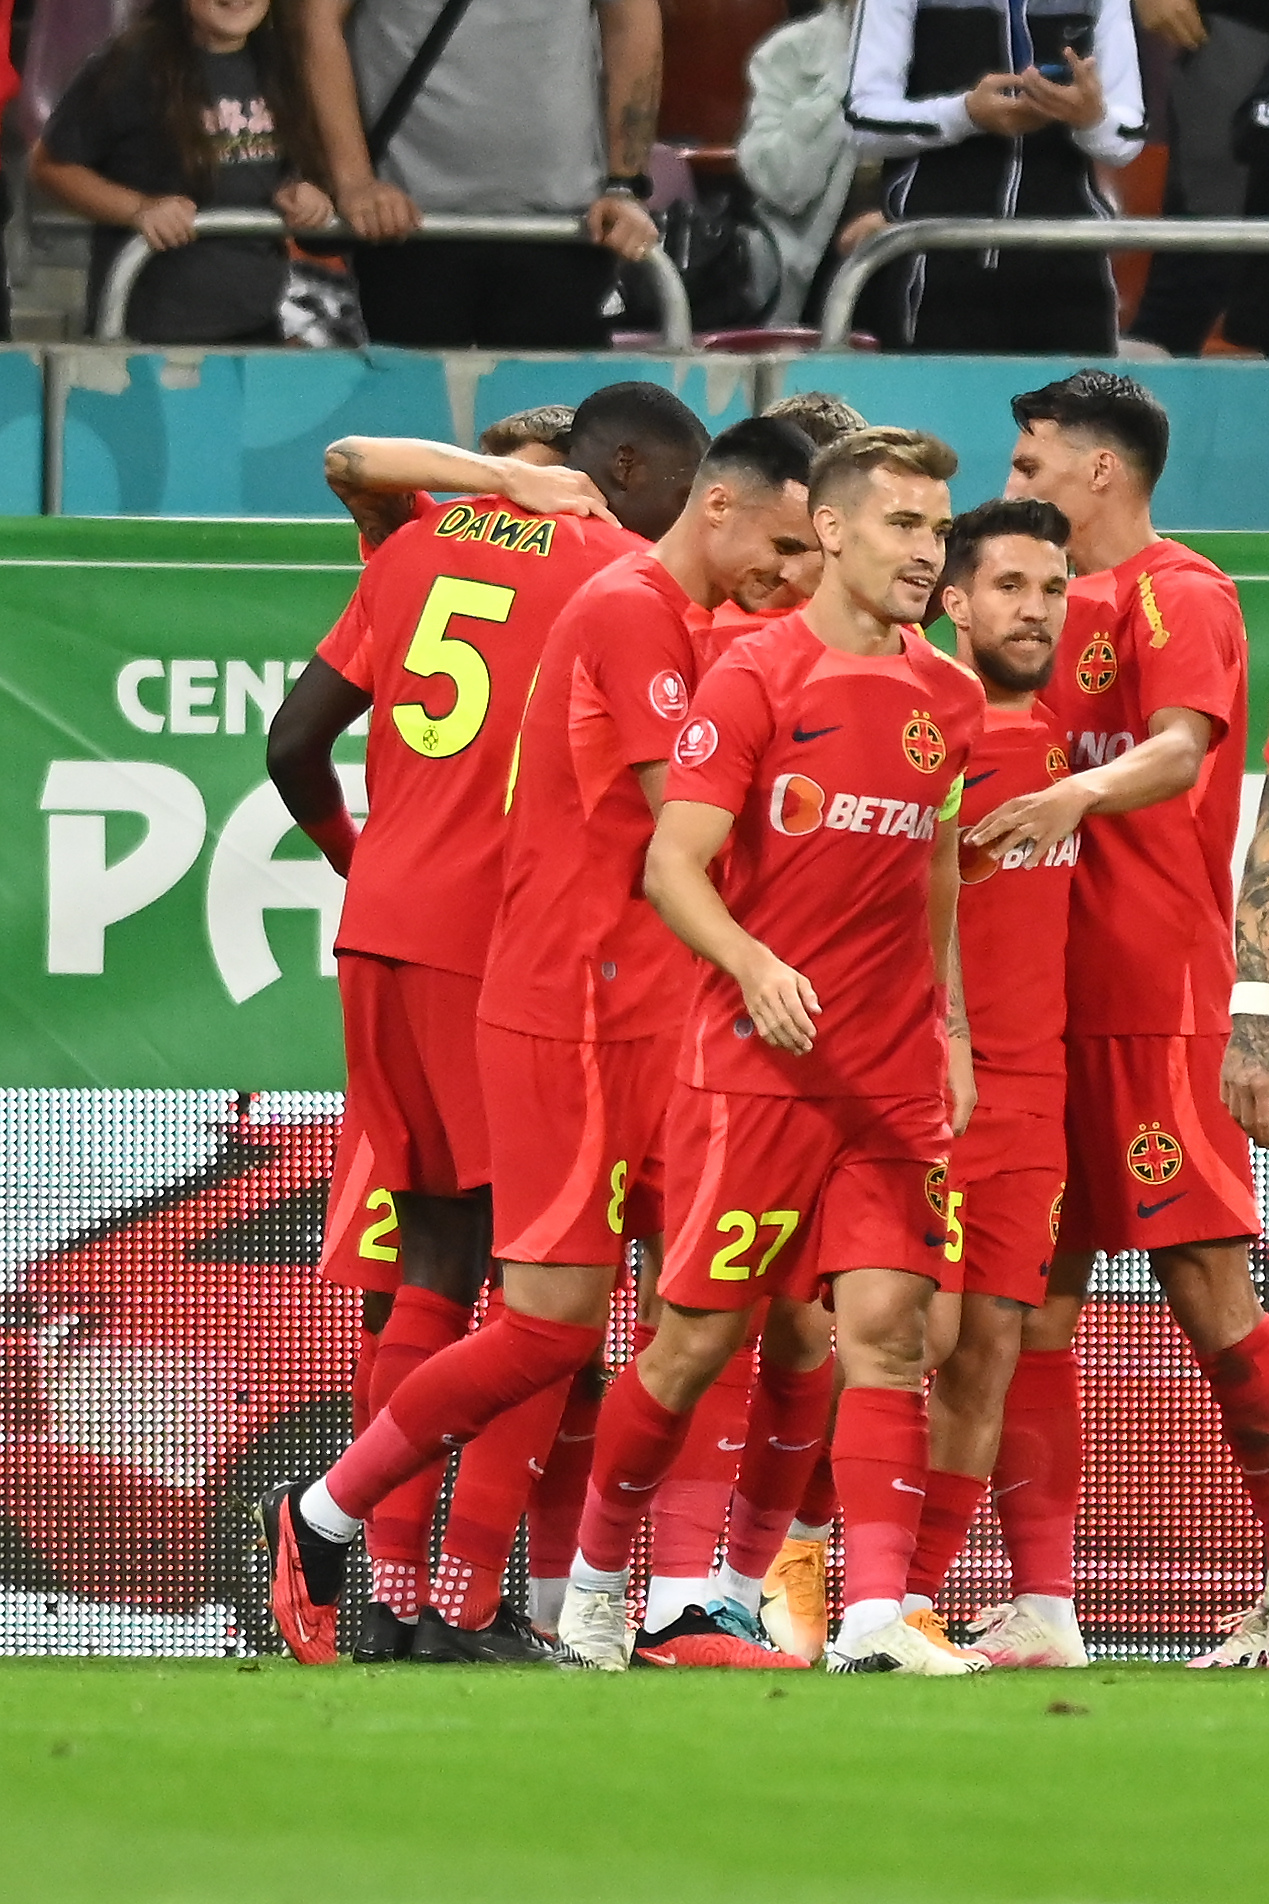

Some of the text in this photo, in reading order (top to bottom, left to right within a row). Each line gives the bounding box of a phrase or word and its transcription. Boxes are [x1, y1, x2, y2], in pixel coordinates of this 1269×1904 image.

[434, 504, 557, 557] DAWA
[116, 658, 310, 735] CEN
[392, 574, 517, 759] 5
[709, 1210, 800, 1281] 27
